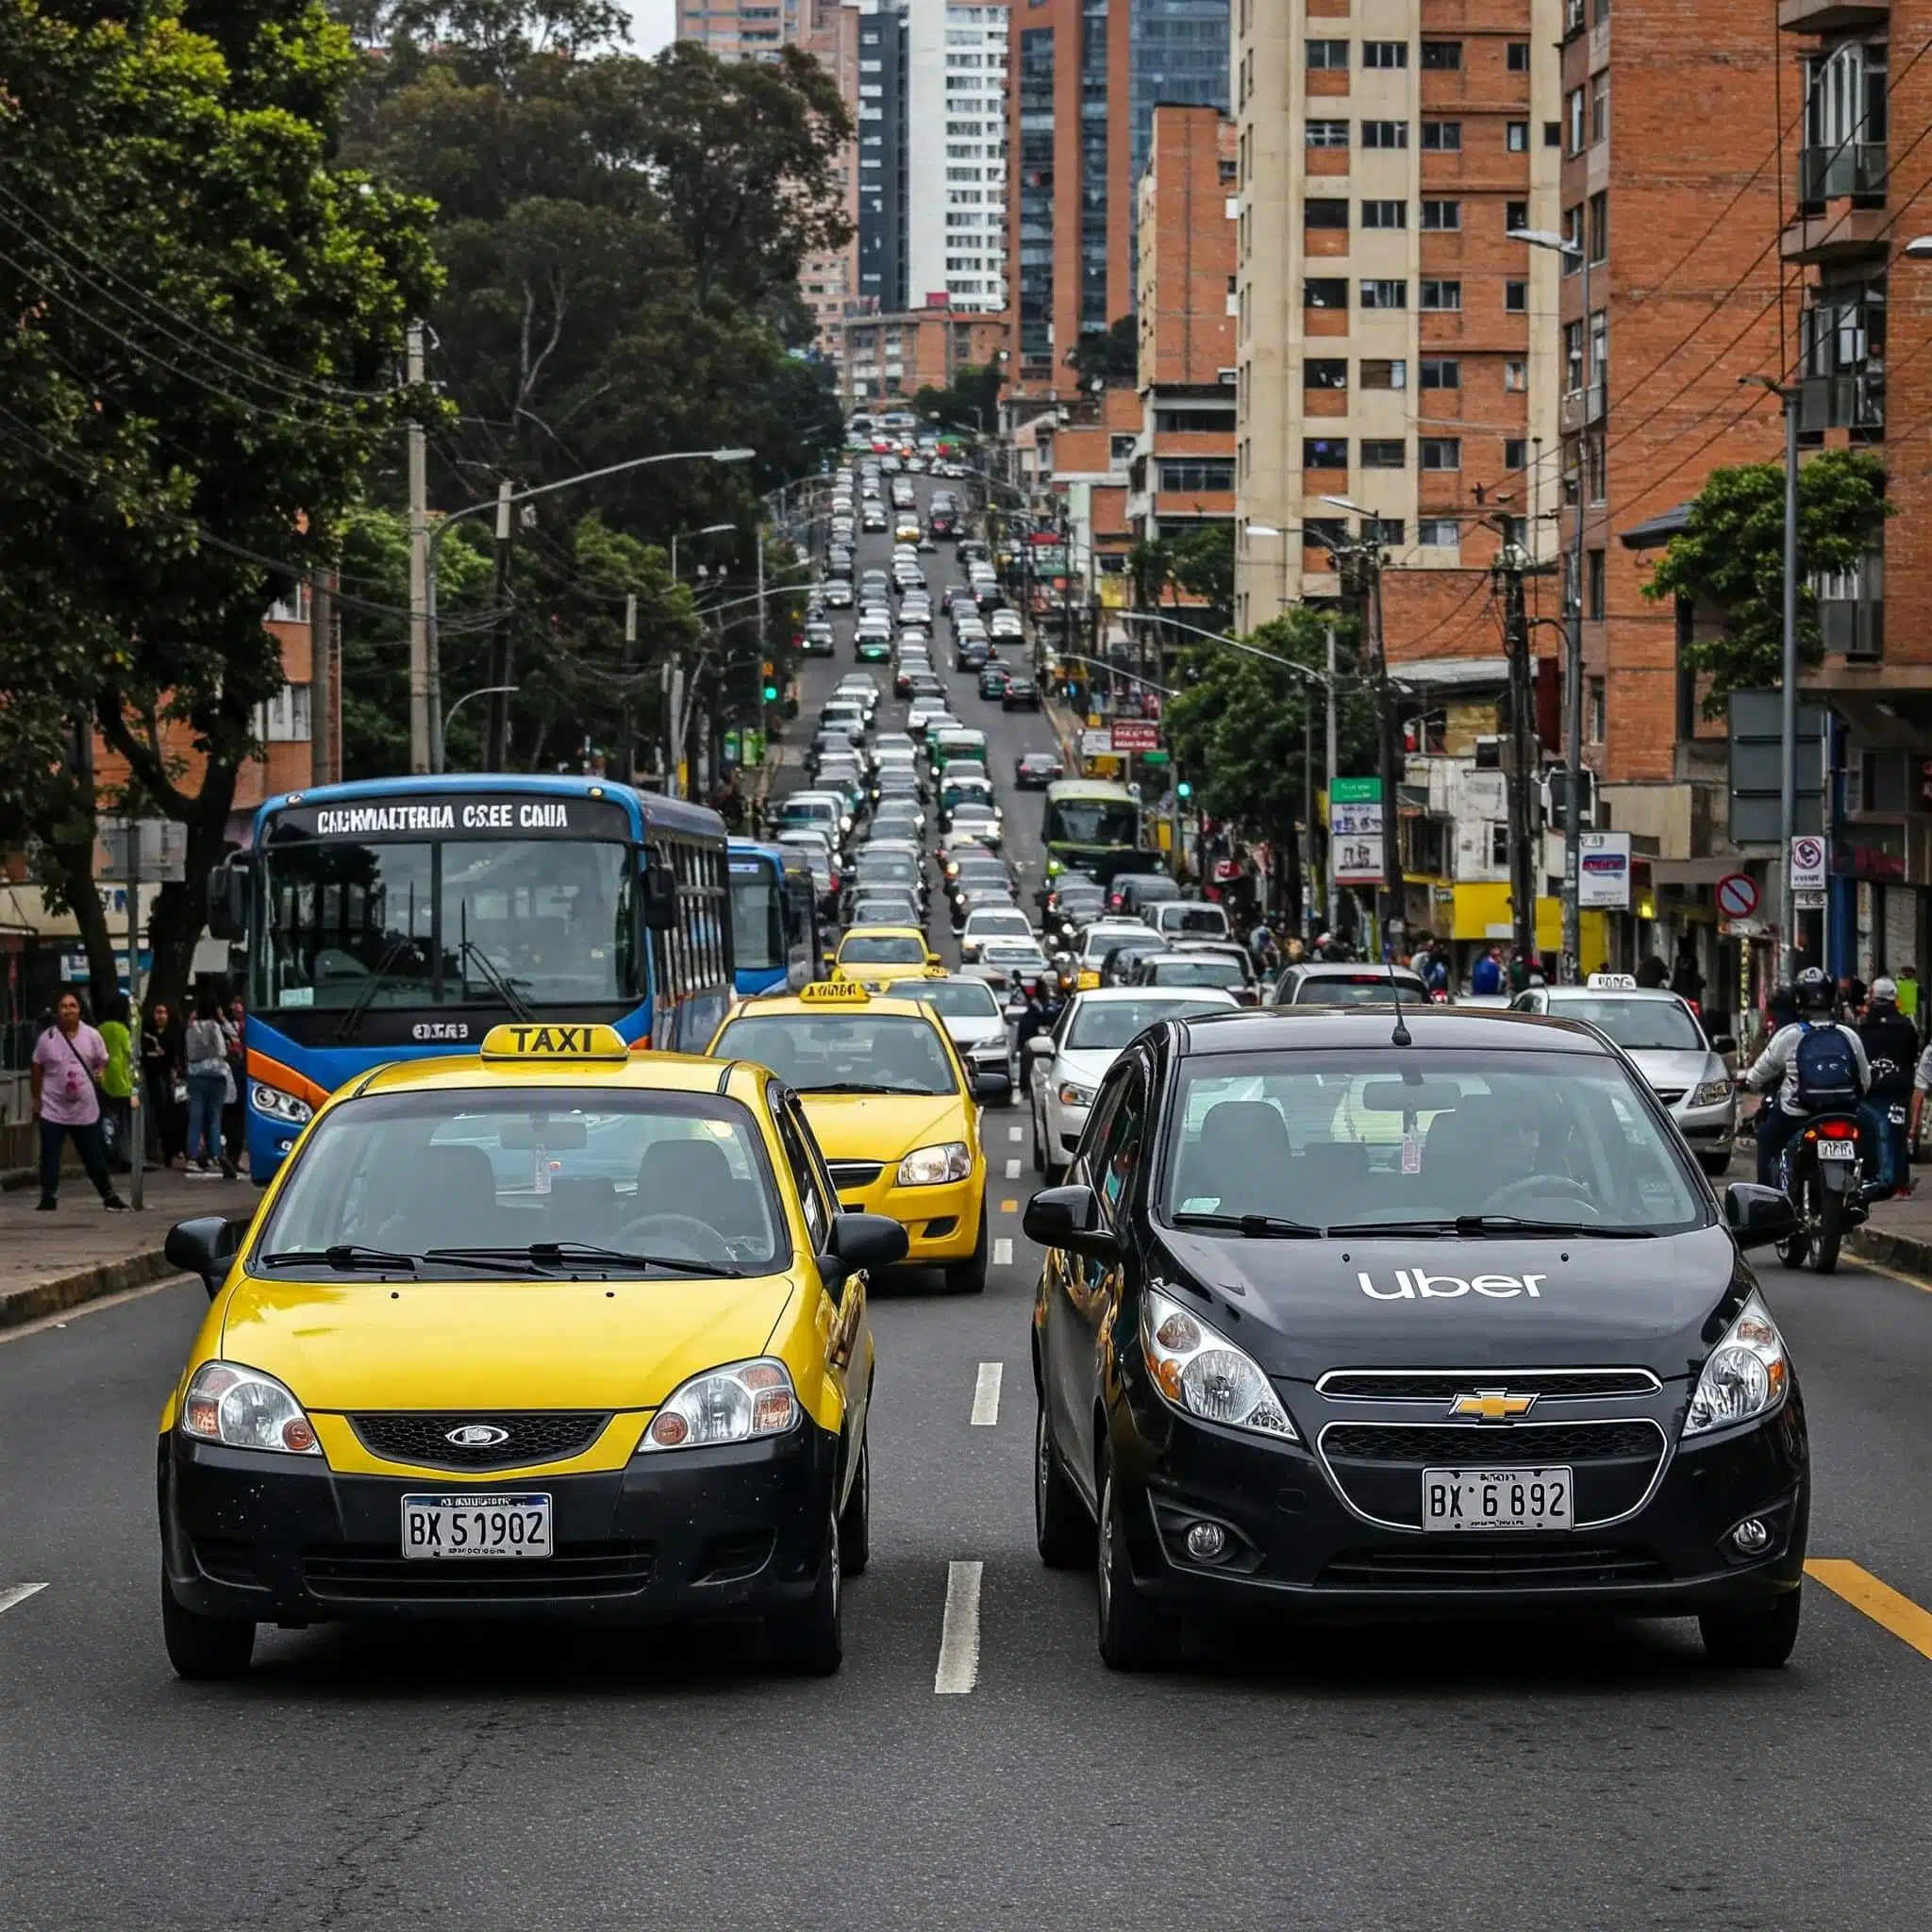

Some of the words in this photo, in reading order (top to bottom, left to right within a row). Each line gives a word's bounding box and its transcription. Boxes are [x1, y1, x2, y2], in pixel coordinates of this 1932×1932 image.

[510, 1028, 594, 1053] TAXI
[1357, 1268, 1547, 1300] Uber
[409, 1512, 441, 1545] BX
